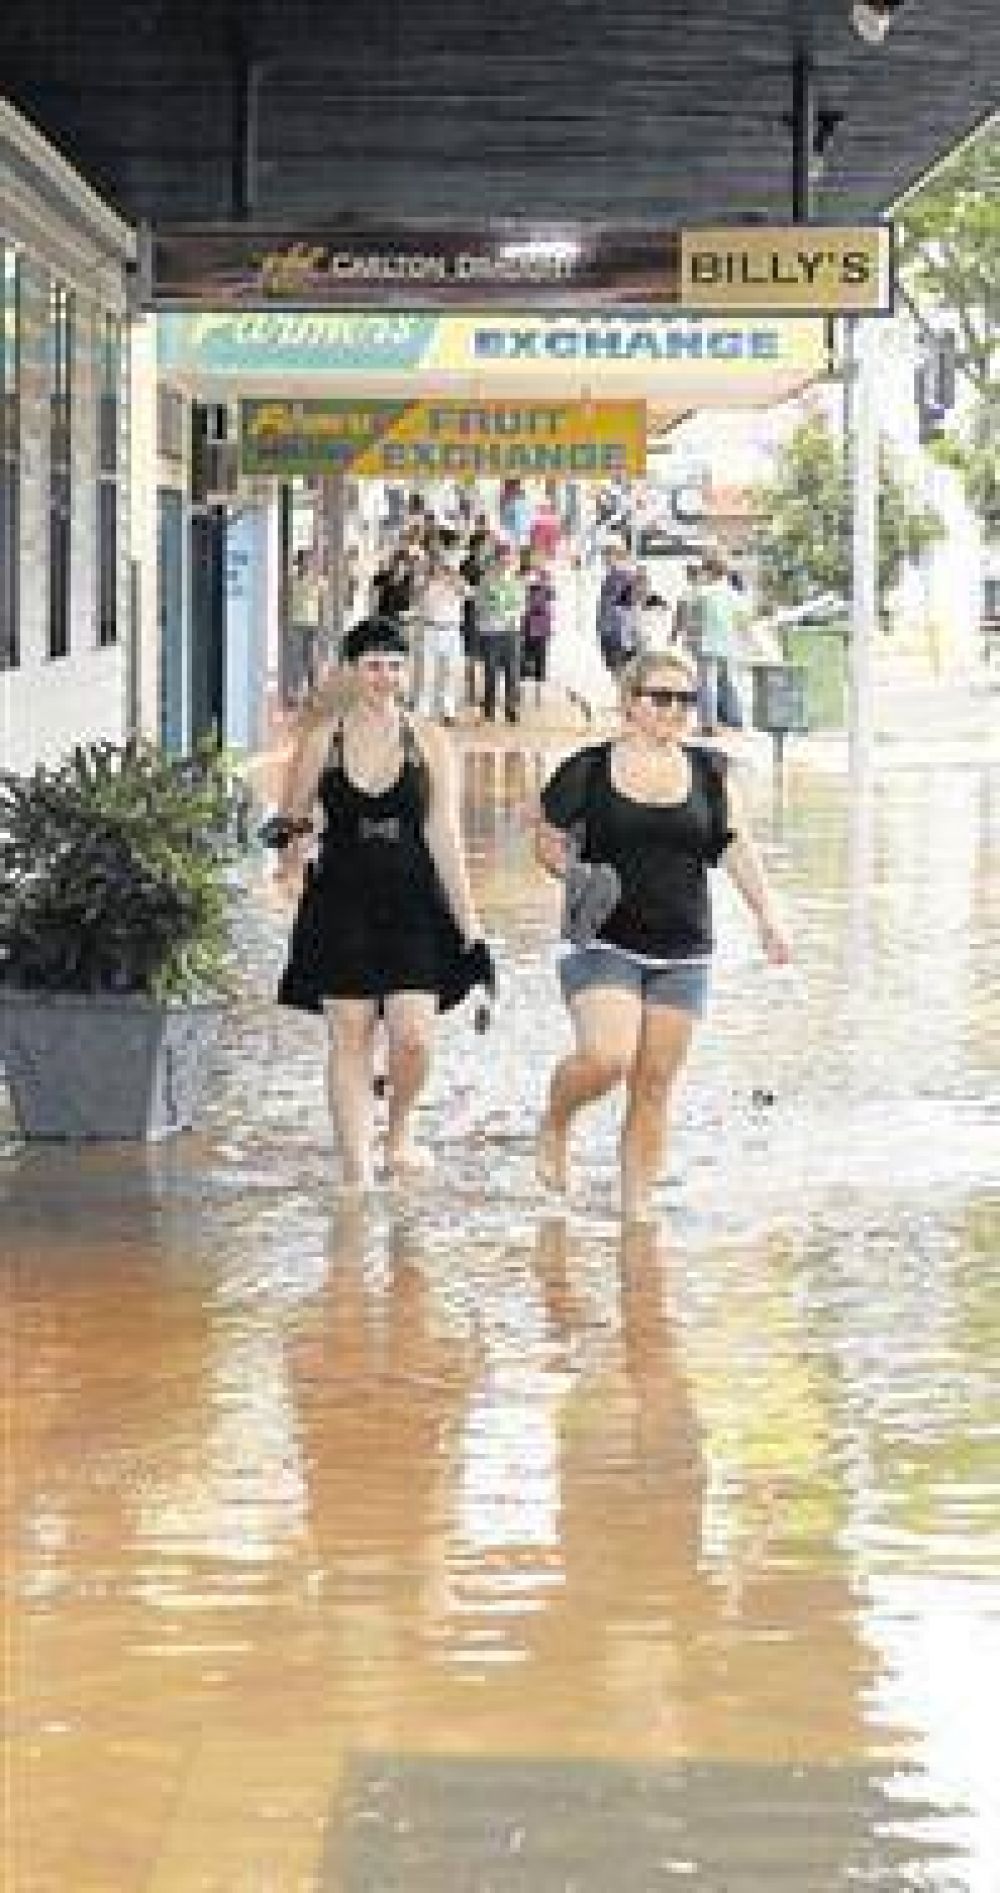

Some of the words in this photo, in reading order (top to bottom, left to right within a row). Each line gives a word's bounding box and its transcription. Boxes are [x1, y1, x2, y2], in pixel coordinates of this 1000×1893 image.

[331, 250, 446, 280] CARLTON
[690, 250, 871, 284] BILLY'S
[474, 328, 780, 359] EXCHANGE
[428, 408, 567, 438] FRUIT
[383, 442, 628, 471] EXCHANGE
